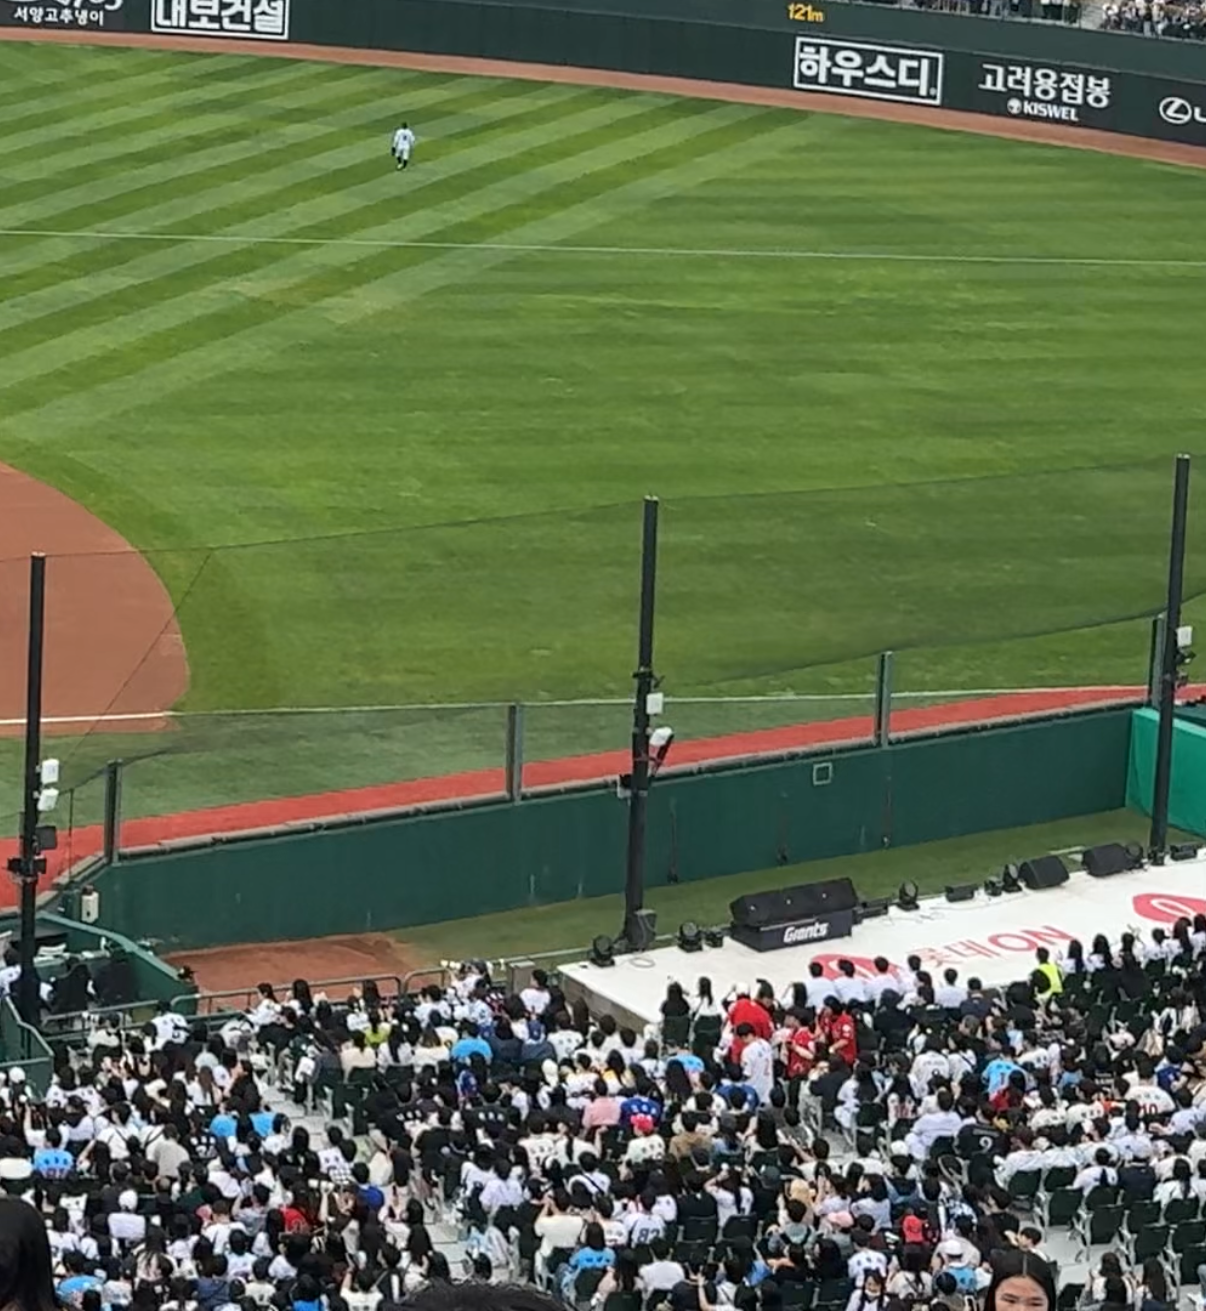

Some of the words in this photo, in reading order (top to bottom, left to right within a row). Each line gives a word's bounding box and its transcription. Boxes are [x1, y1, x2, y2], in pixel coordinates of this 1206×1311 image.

[14, 6, 104, 26] 서양고추냉이
[787, 3, 825, 23] 121m
[798, 46, 930, 97] 하우스디
[979, 63, 1111, 108] 고려용접봉
[1022, 102, 1079, 123] KISWEL
[783, 921, 829, 943] Giants
